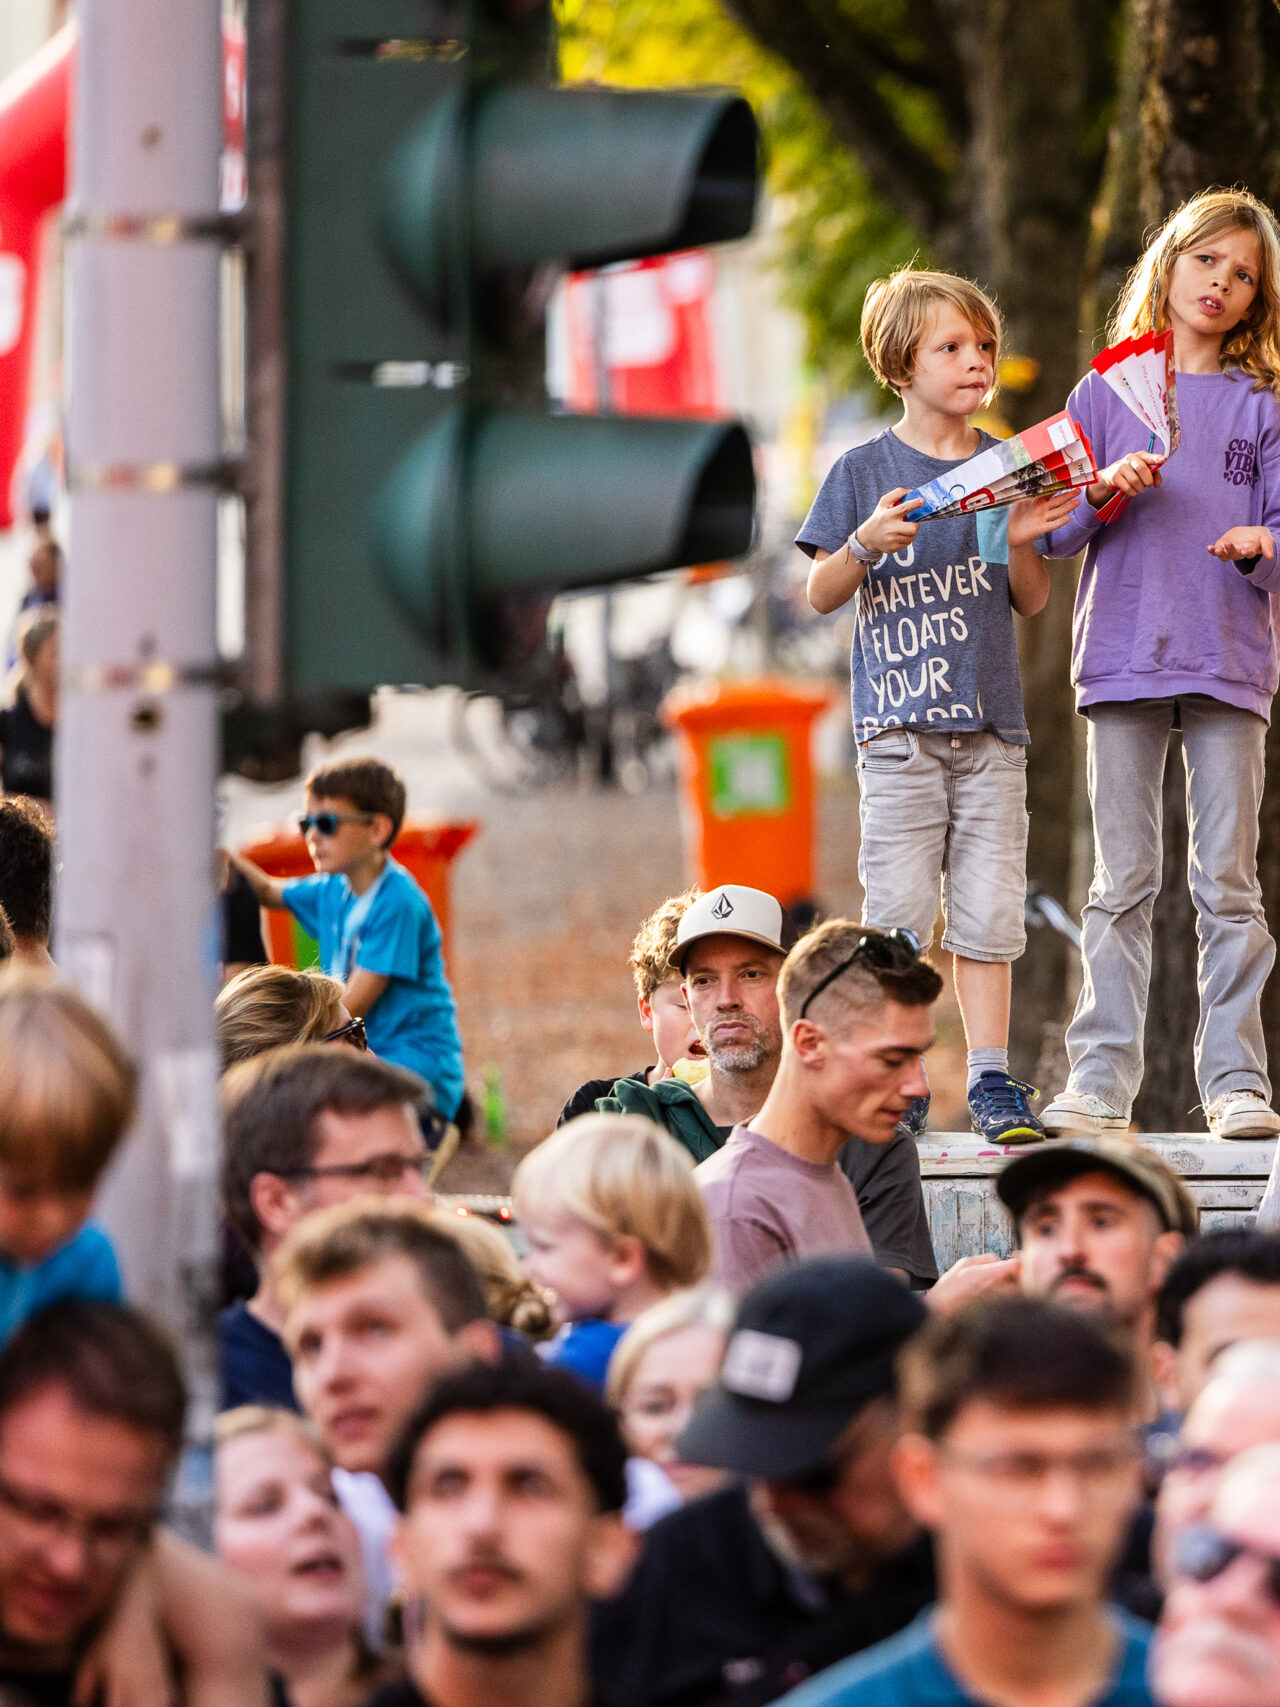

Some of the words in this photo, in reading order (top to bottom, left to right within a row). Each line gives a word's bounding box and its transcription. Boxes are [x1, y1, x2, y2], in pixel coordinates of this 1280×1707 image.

[860, 556, 992, 627] WHATEVER
[872, 606, 969, 664] FLOATS
[869, 656, 952, 714] YOUR
